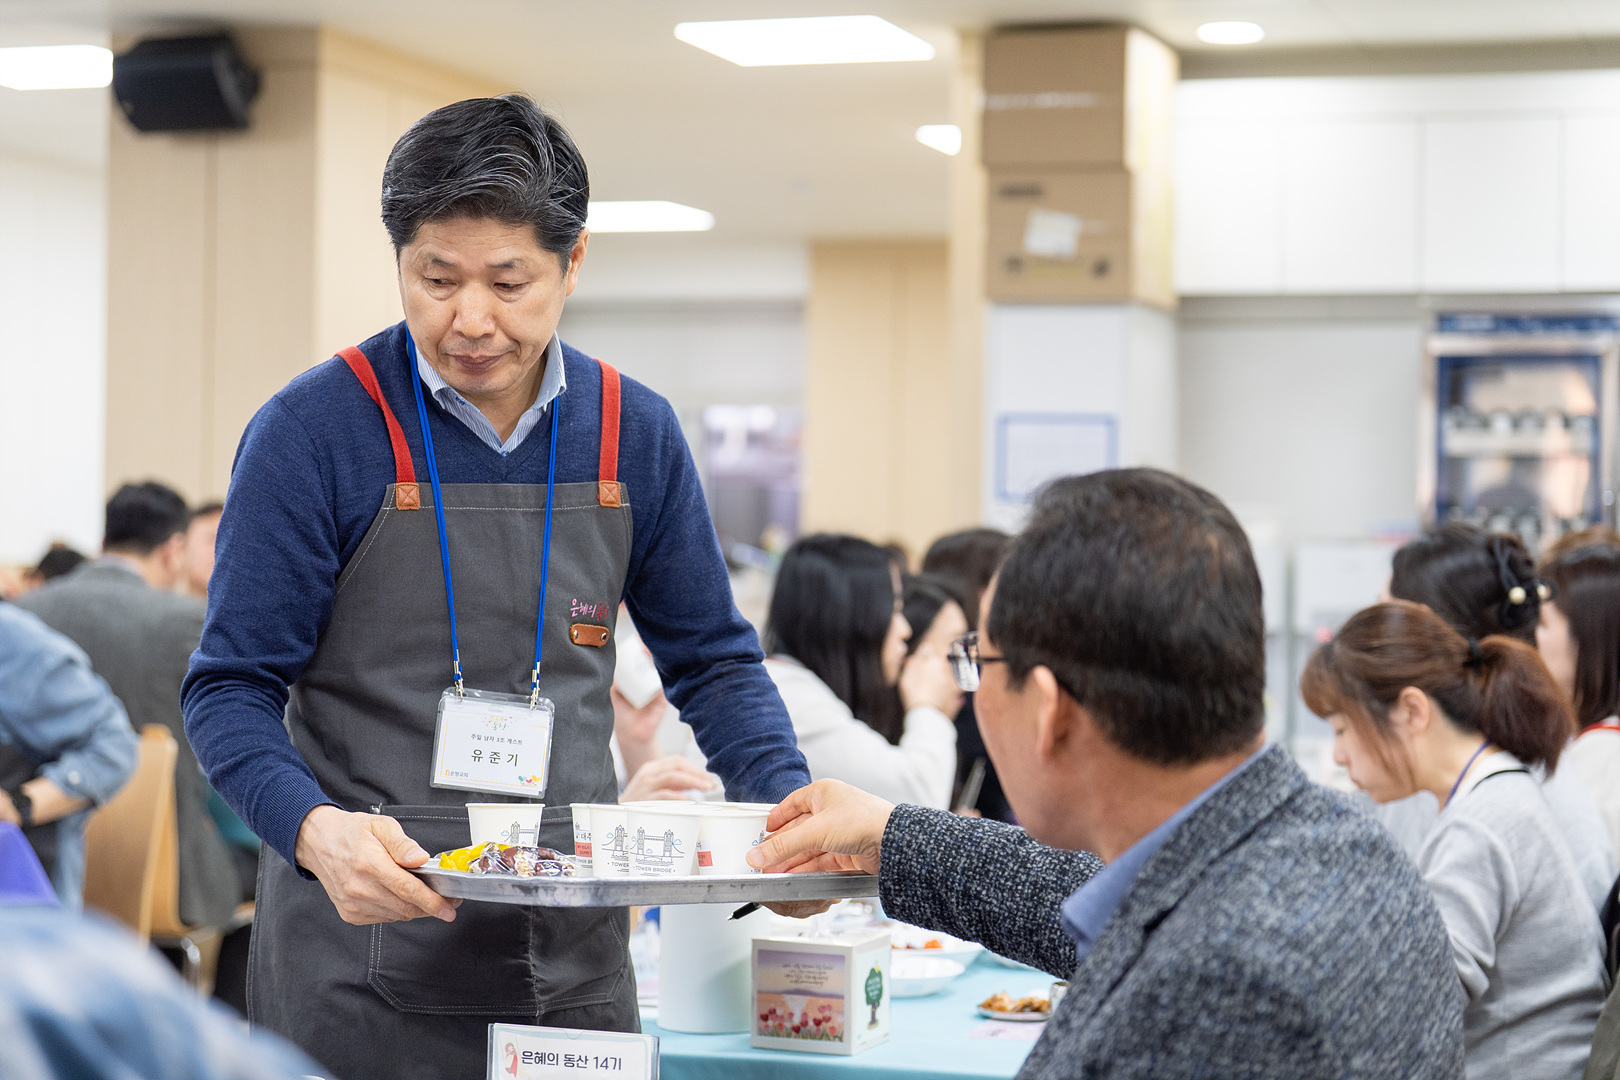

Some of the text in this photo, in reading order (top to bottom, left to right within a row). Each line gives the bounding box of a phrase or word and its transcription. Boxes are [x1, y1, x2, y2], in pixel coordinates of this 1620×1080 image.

[570, 598, 597, 618] 은혜의
[471, 733, 482, 741] 주일
[521, 1050, 622, 1071] 은혜의 동산 14기
